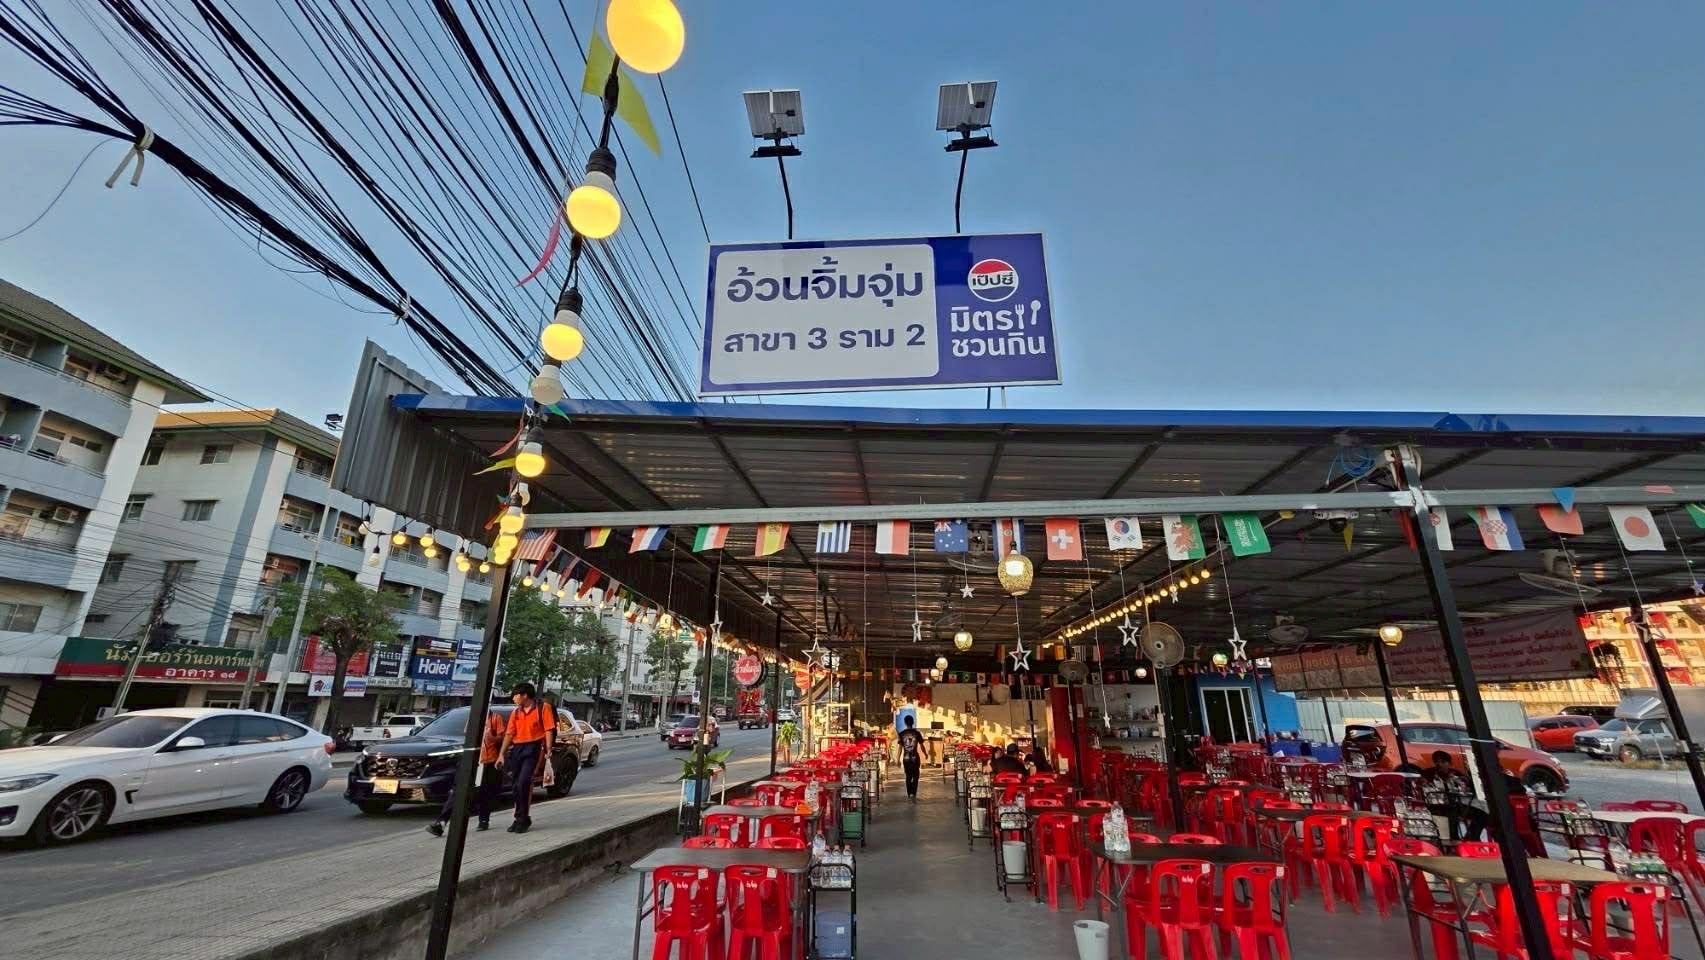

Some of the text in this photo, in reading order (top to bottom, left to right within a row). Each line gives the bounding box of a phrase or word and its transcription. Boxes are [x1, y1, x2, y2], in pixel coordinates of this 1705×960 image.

[727, 256, 923, 307] อ้วนจิ้มจุ่ม
[951, 306, 1014, 332] มิตร
[724, 323, 926, 352] สาขา 3 ราม 2
[952, 332, 1046, 357] ชวนกิน
[165, 667, 215, 678] อาคาร
[418, 657, 451, 675] Haier
